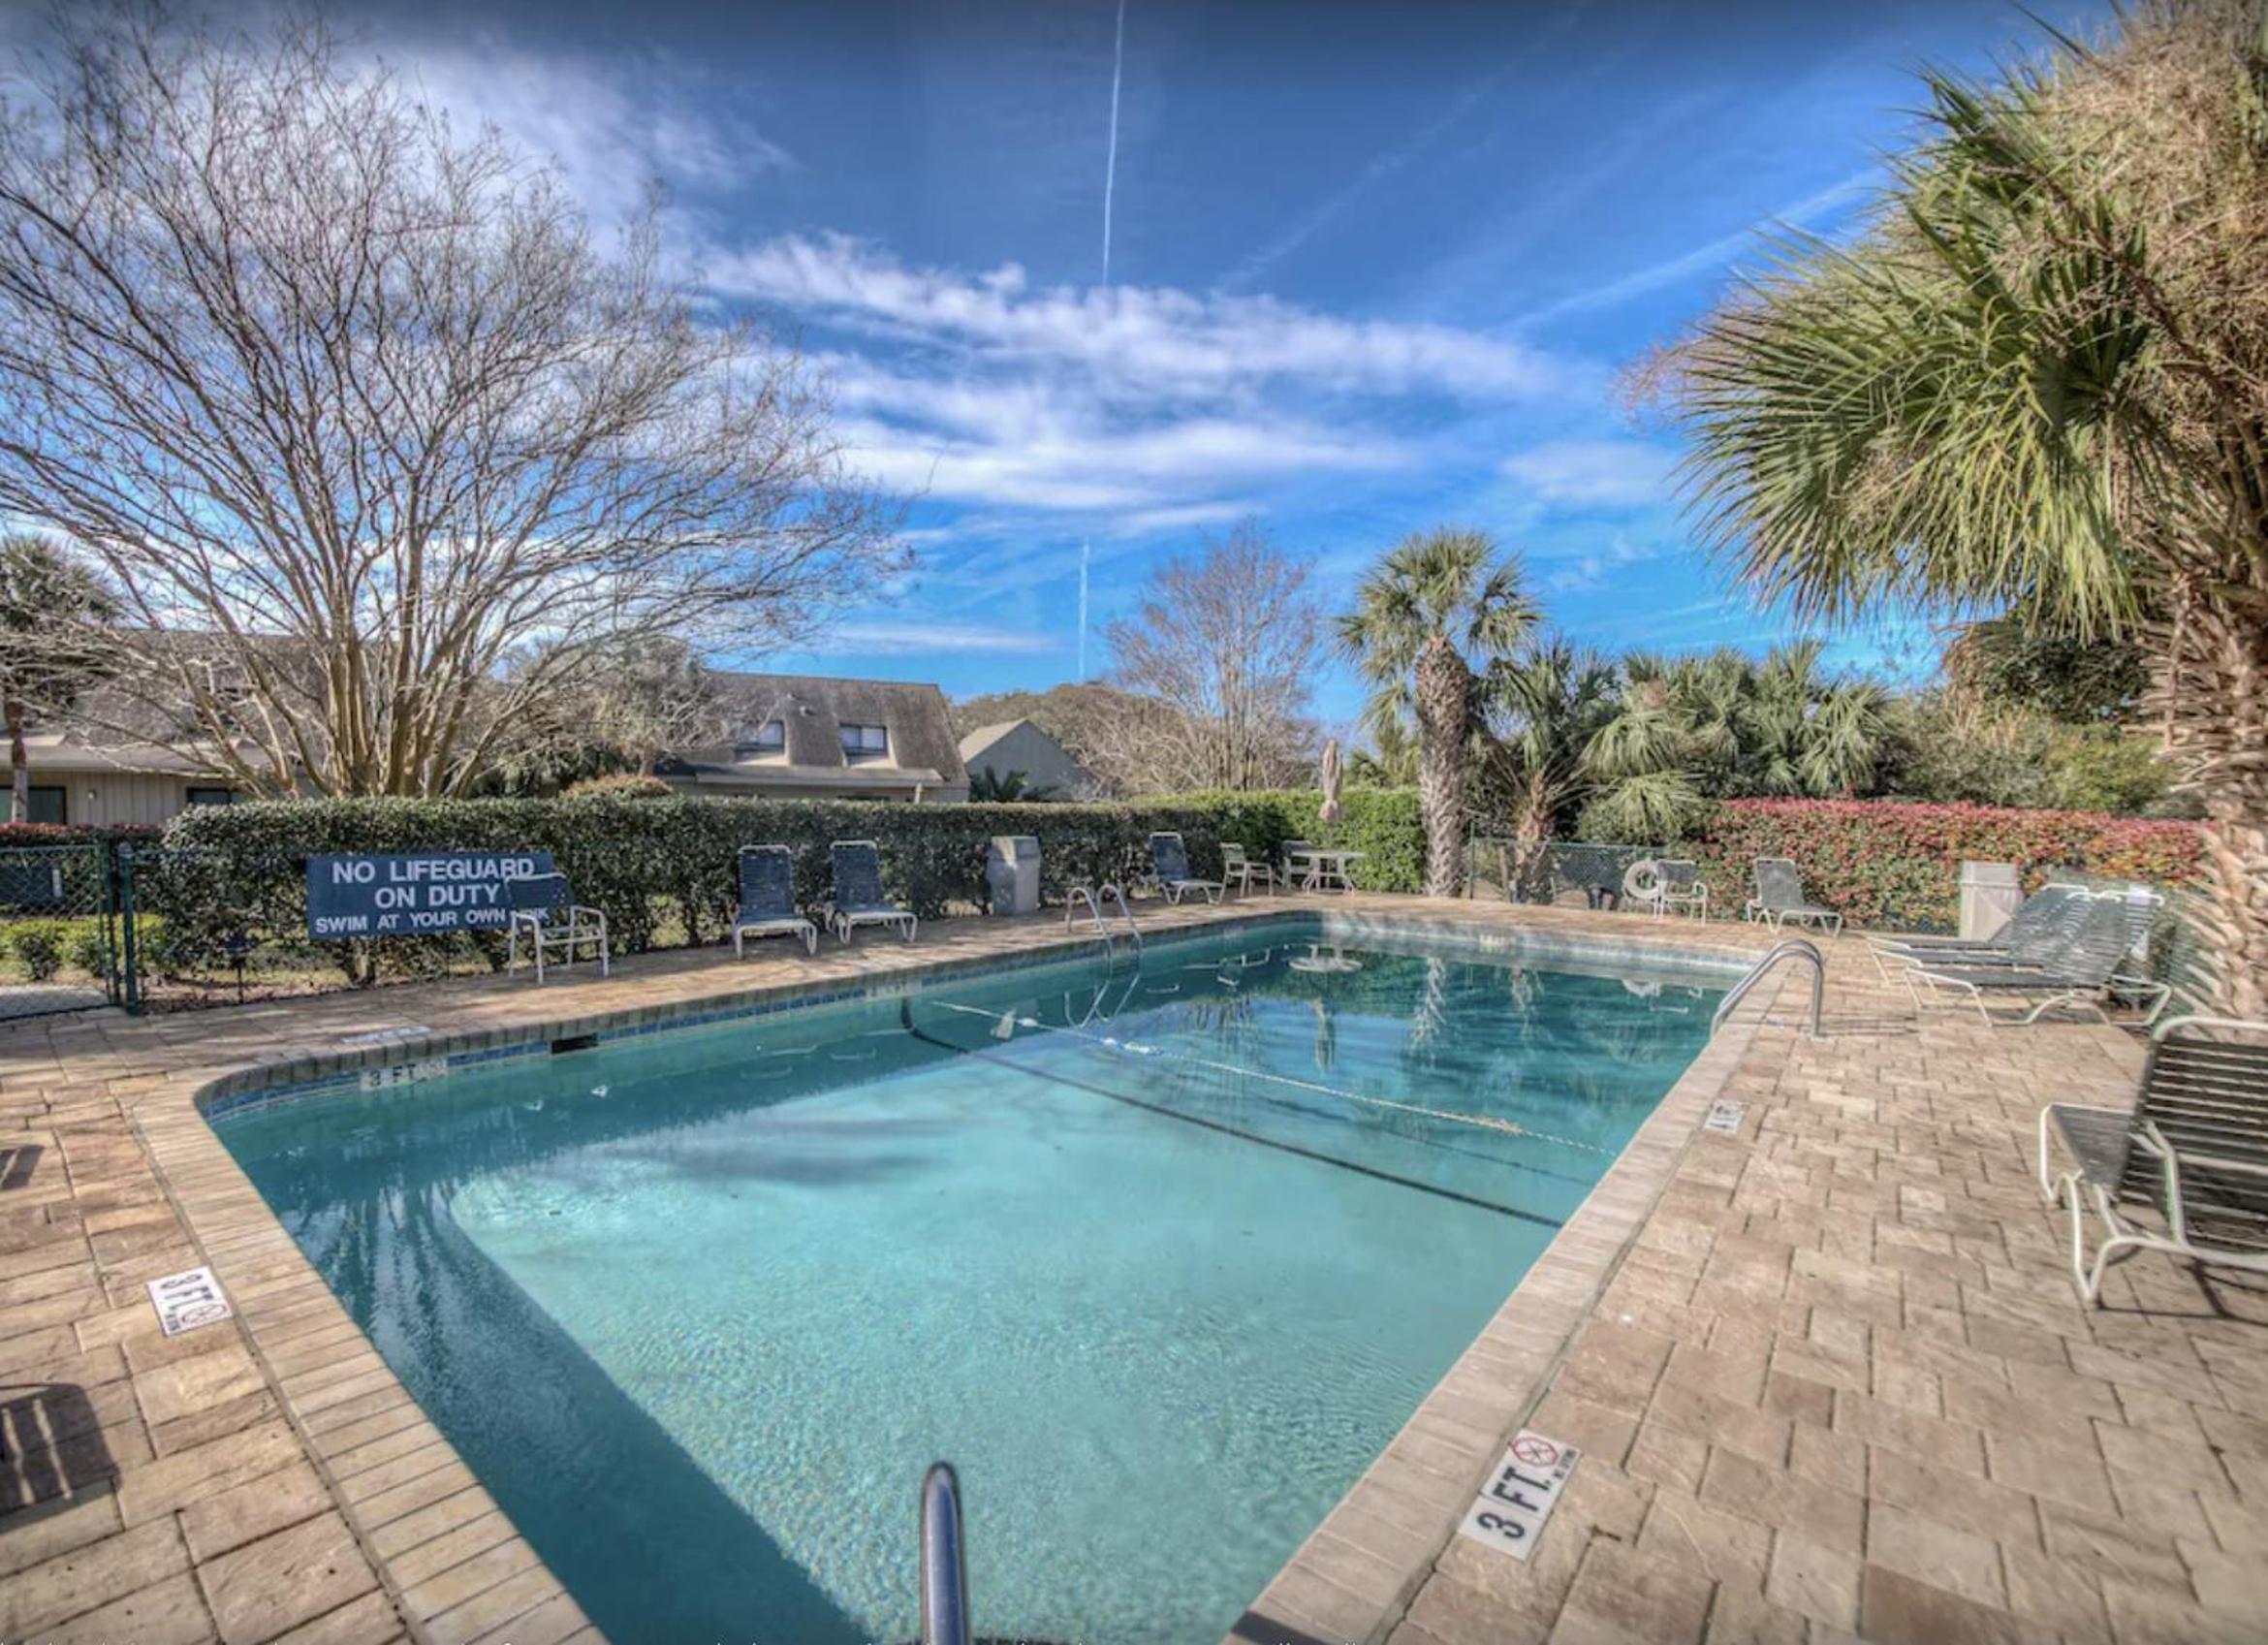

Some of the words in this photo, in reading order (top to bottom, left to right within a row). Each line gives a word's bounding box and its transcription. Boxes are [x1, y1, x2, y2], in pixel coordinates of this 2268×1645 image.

[332, 860, 376, 884] NO
[390, 858, 535, 882] LIFEGUARD
[374, 886, 417, 909] ON
[428, 883, 500, 907] DUTY
[315, 915, 367, 933] SWIM
[376, 913, 400, 930] AT
[409, 910, 457, 928] YOUR
[465, 907, 506, 925] OWN
[1476, 1511, 1526, 1540] 3
